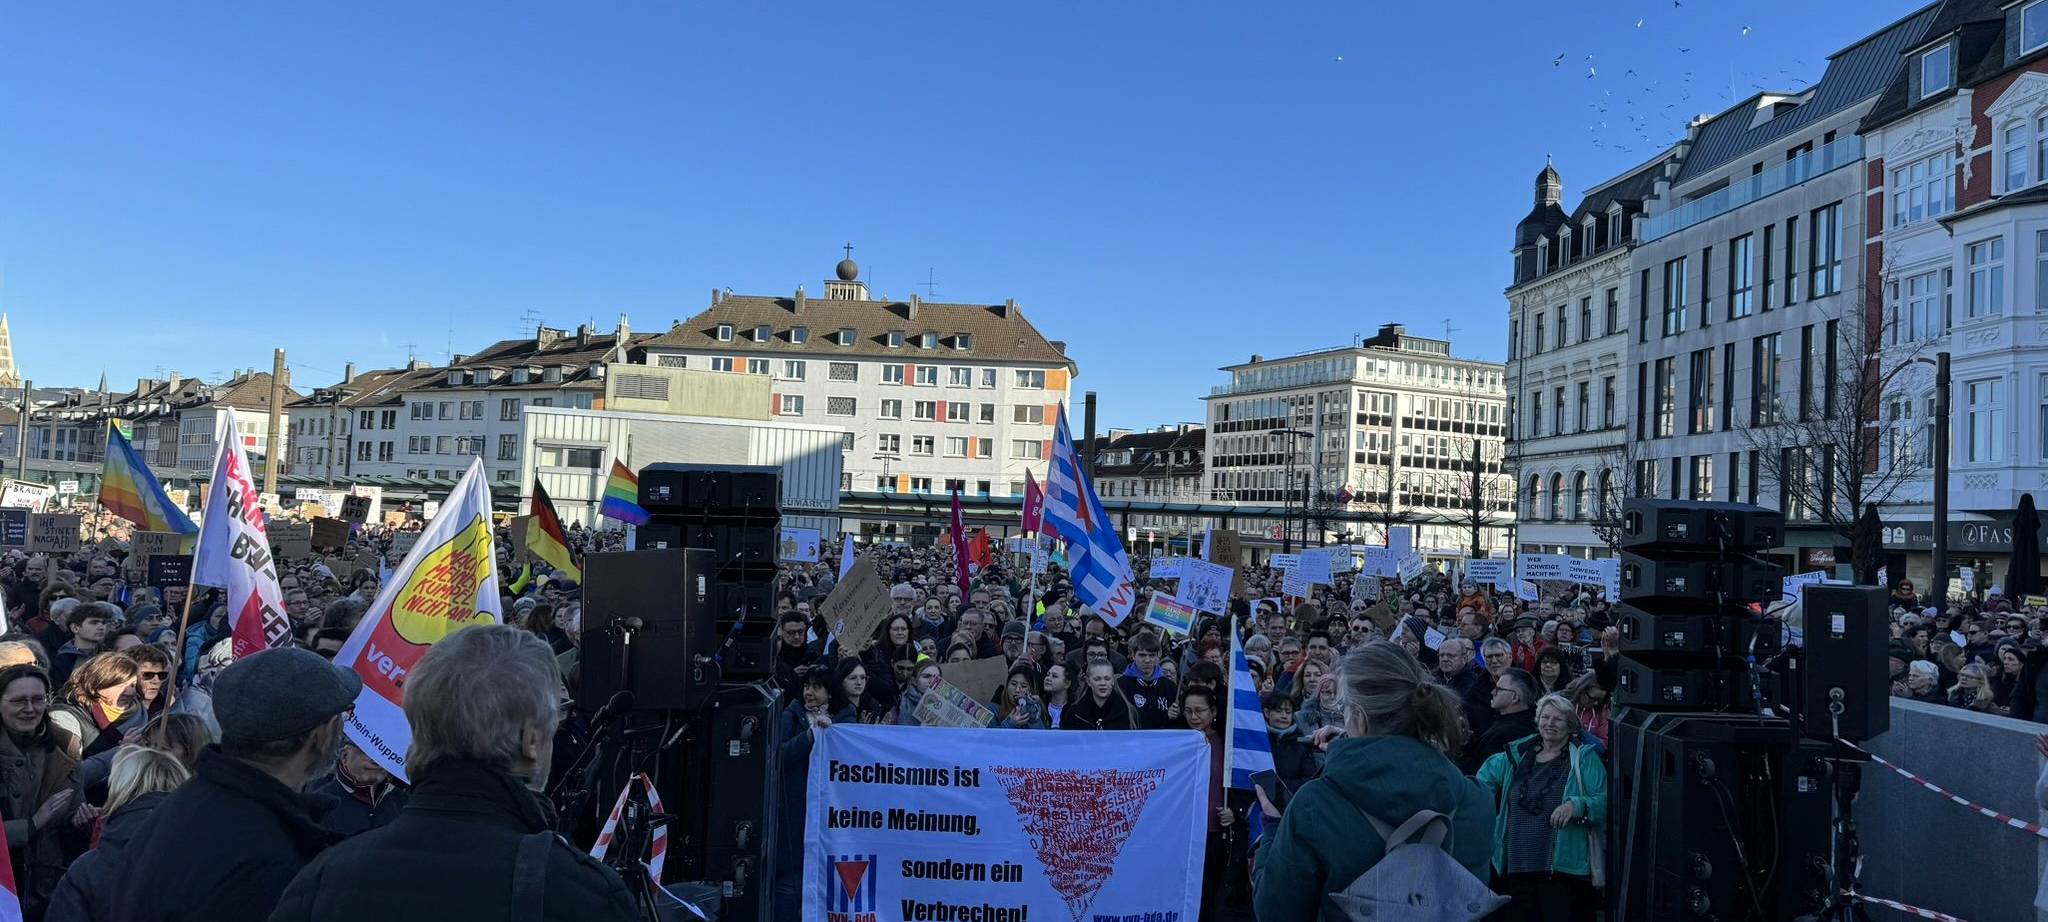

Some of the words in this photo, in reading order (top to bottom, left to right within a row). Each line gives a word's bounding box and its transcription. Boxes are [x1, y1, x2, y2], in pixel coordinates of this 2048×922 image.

[1979, 525, 2013, 543] FAS
[1526, 563, 1560, 571] SCHWEIGT,
[1569, 566, 1601, 576] CHWEIGT,
[1569, 572, 1587, 580] ACHT
[402, 594, 451, 618] NICHT
[829, 760, 950, 787] Faschismus
[954, 765, 980, 787] ist
[828, 806, 883, 829] keine
[888, 808, 981, 837] Meinung,
[901, 859, 986, 882] sondern
[990, 860, 1022, 882] ein
[901, 899, 1028, 922] Verbrechen!
